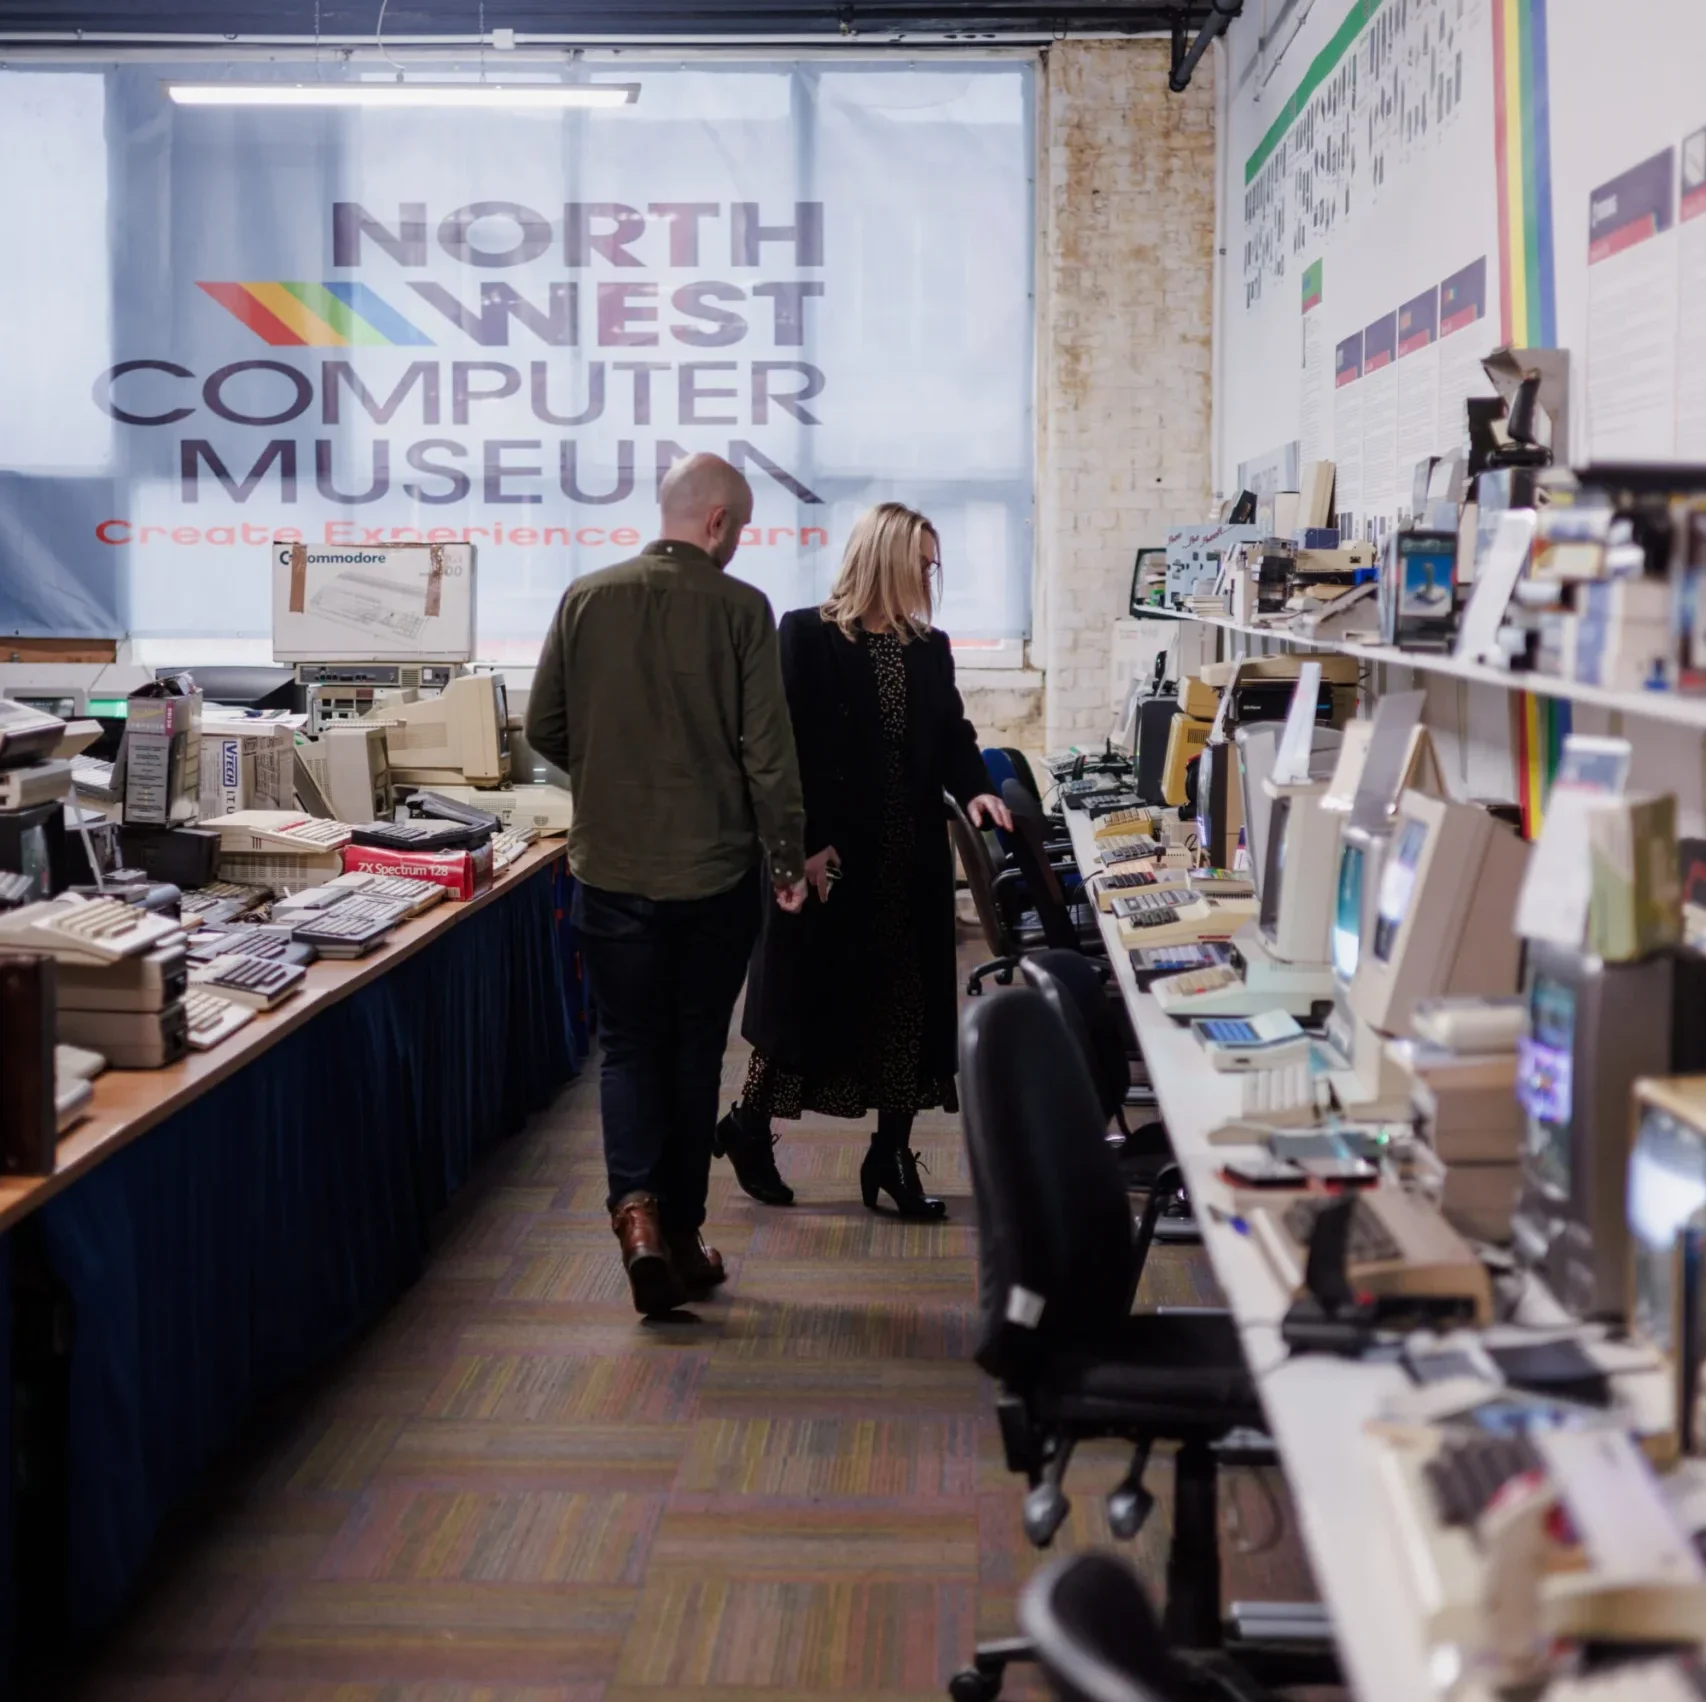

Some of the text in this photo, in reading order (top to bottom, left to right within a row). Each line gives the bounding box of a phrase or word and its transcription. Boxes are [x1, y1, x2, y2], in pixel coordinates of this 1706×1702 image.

[333, 201, 824, 268] NORTH
[405, 281, 824, 347] WEST
[92, 360, 826, 426] COMPUTER
[95, 519, 303, 546] Create
[324, 521, 640, 547] Experience
[306, 552, 386, 564] ommodore
[224, 742, 238, 785] VTECH
[358, 862, 449, 877] ZX Spectrum 128
